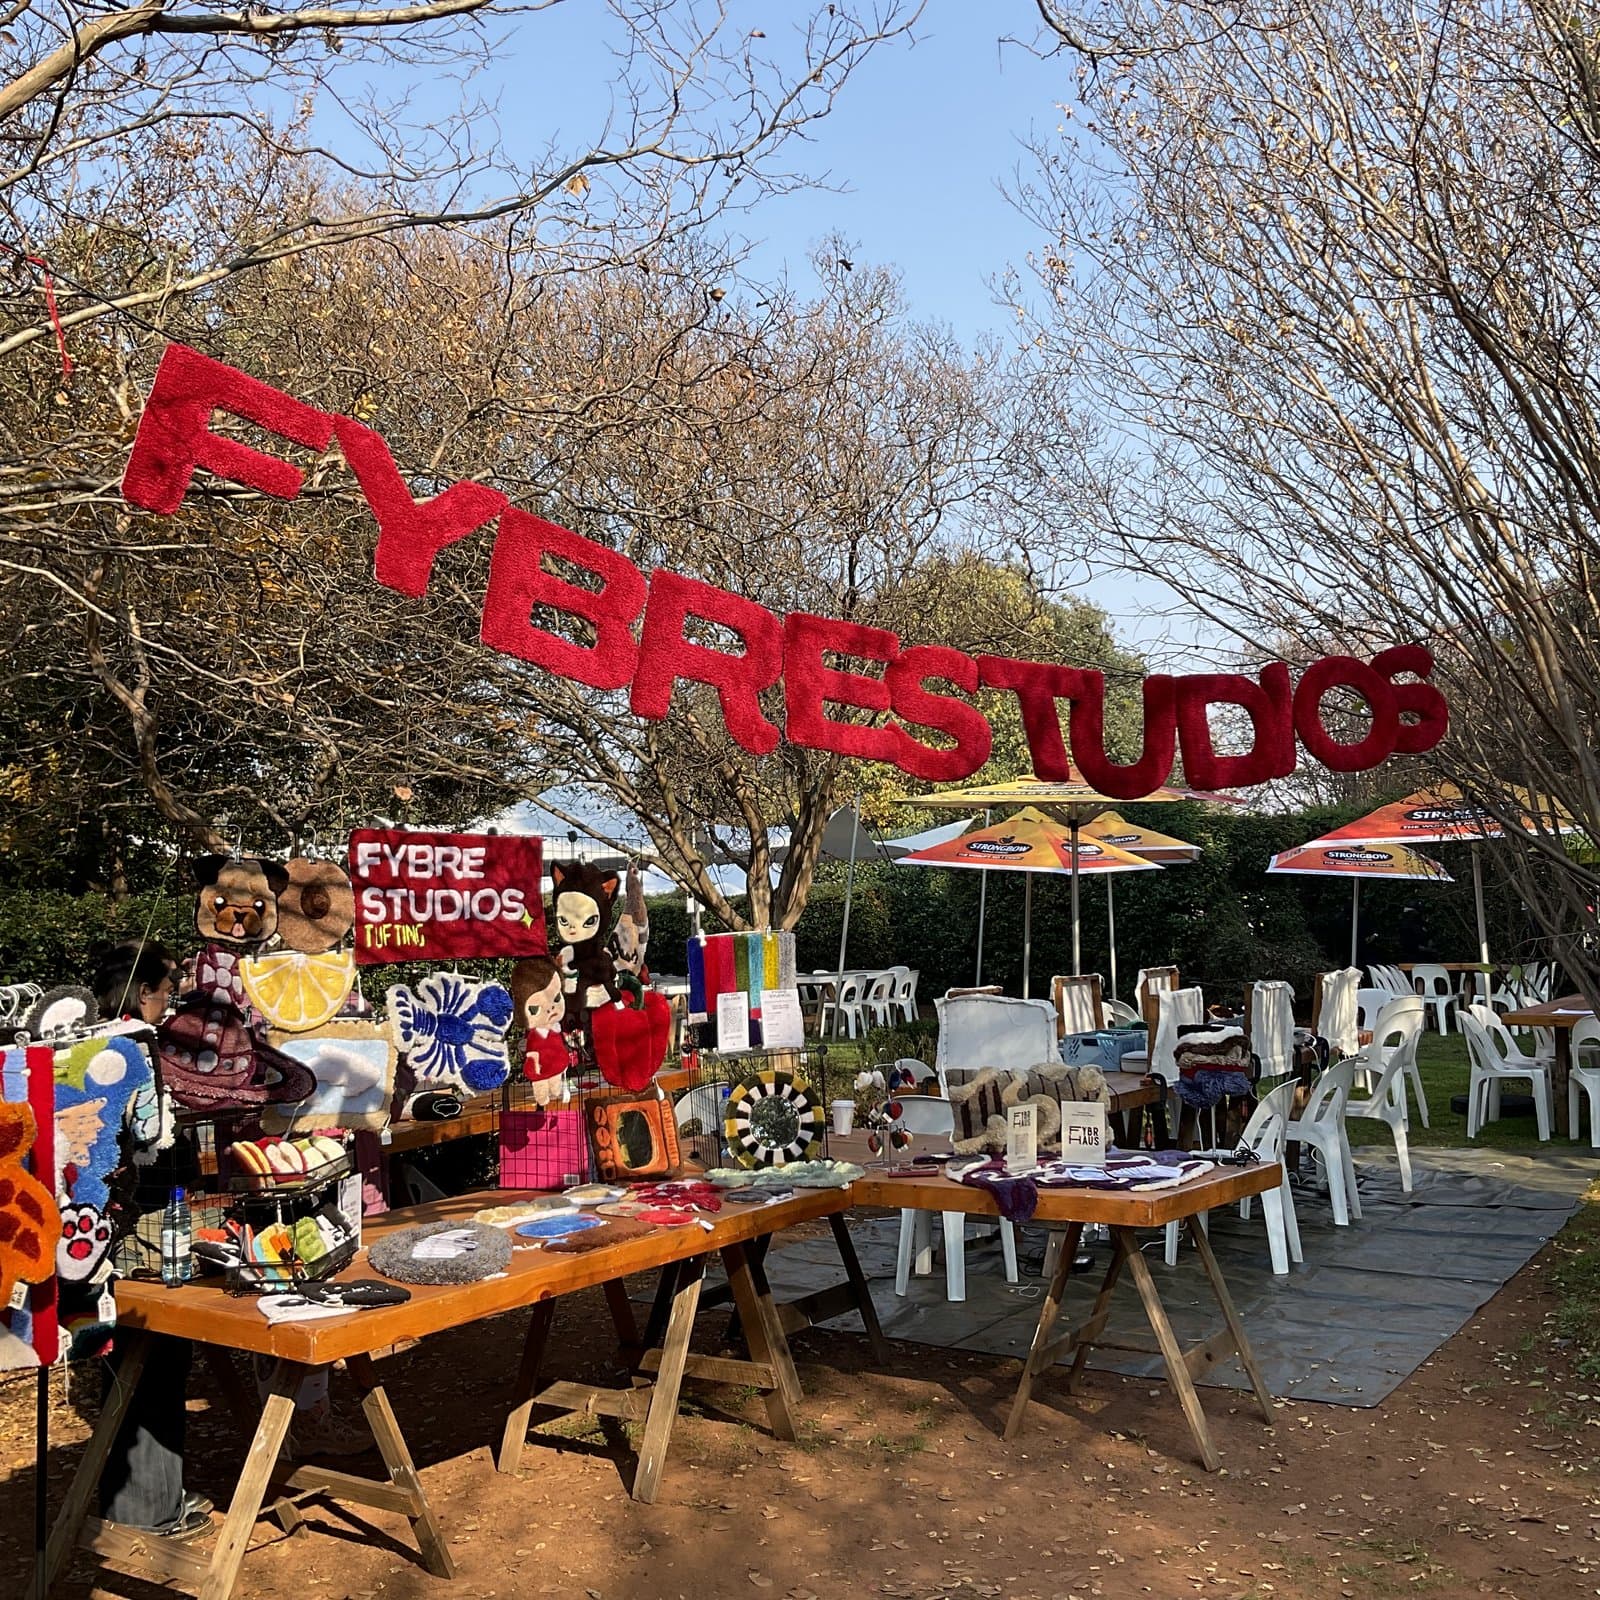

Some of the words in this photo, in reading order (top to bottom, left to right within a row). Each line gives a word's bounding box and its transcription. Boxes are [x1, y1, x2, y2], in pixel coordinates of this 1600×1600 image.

[970, 842, 1030, 852] STRONGBOW
[1328, 851, 1389, 860] STRONGBOW
[357, 842, 486, 880] FYBRE
[361, 887, 525, 922] STUDIOS
[364, 923, 426, 948] TUFTING
[1069, 1135, 1100, 1146] HAUS
